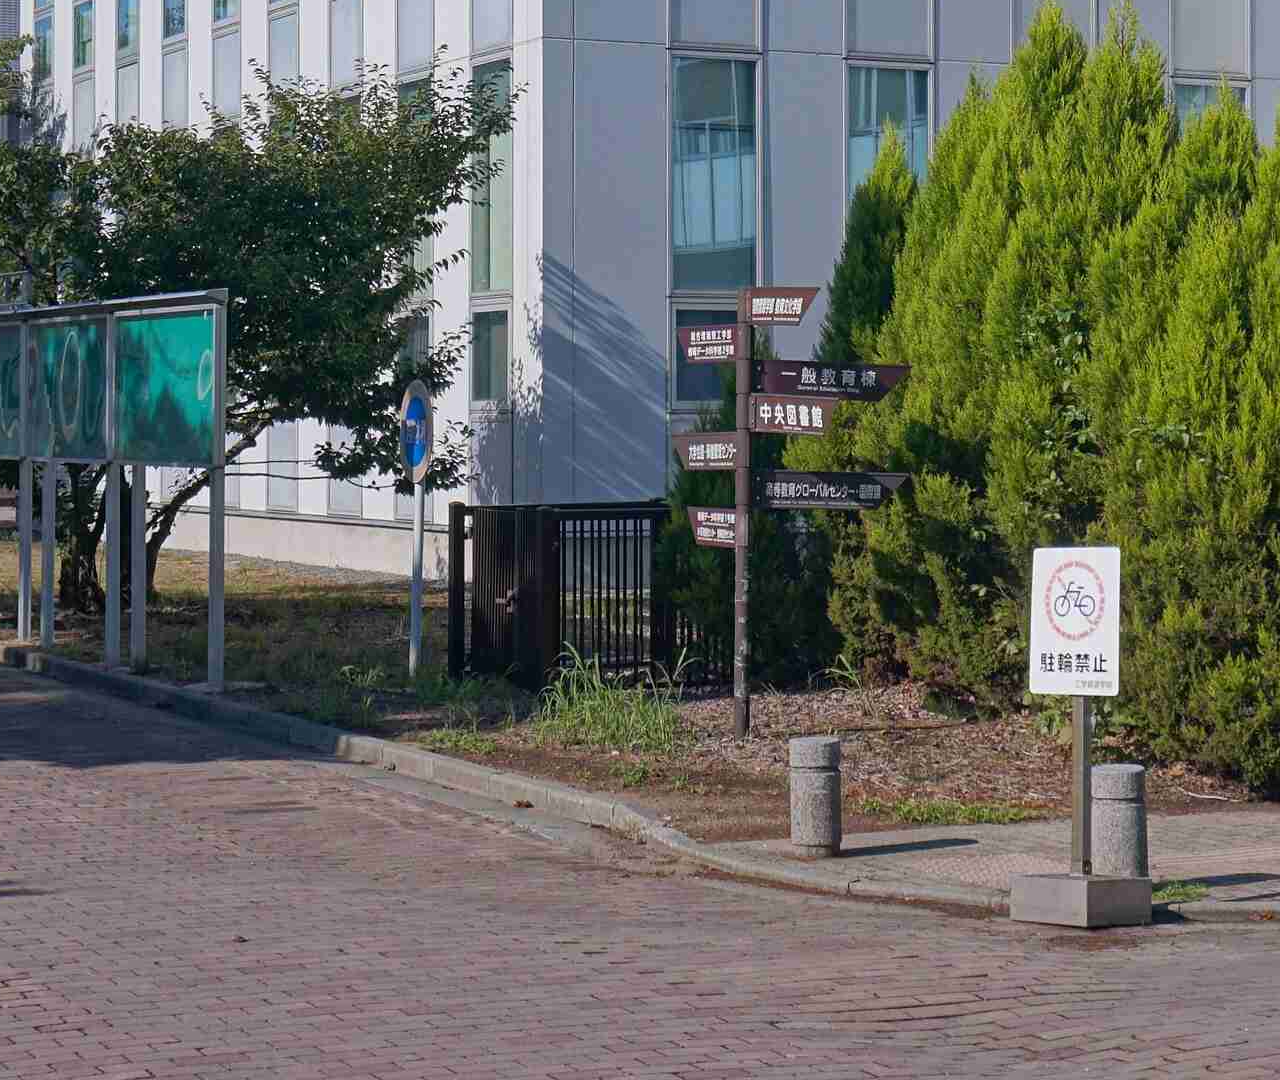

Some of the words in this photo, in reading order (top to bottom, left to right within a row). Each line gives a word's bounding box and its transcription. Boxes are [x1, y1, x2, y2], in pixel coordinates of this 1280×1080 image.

[780, 366, 877, 387] 一般教育棟
[759, 402, 823, 428] 中央図書館
[1039, 652, 1108, 672] 駐輪禁止
